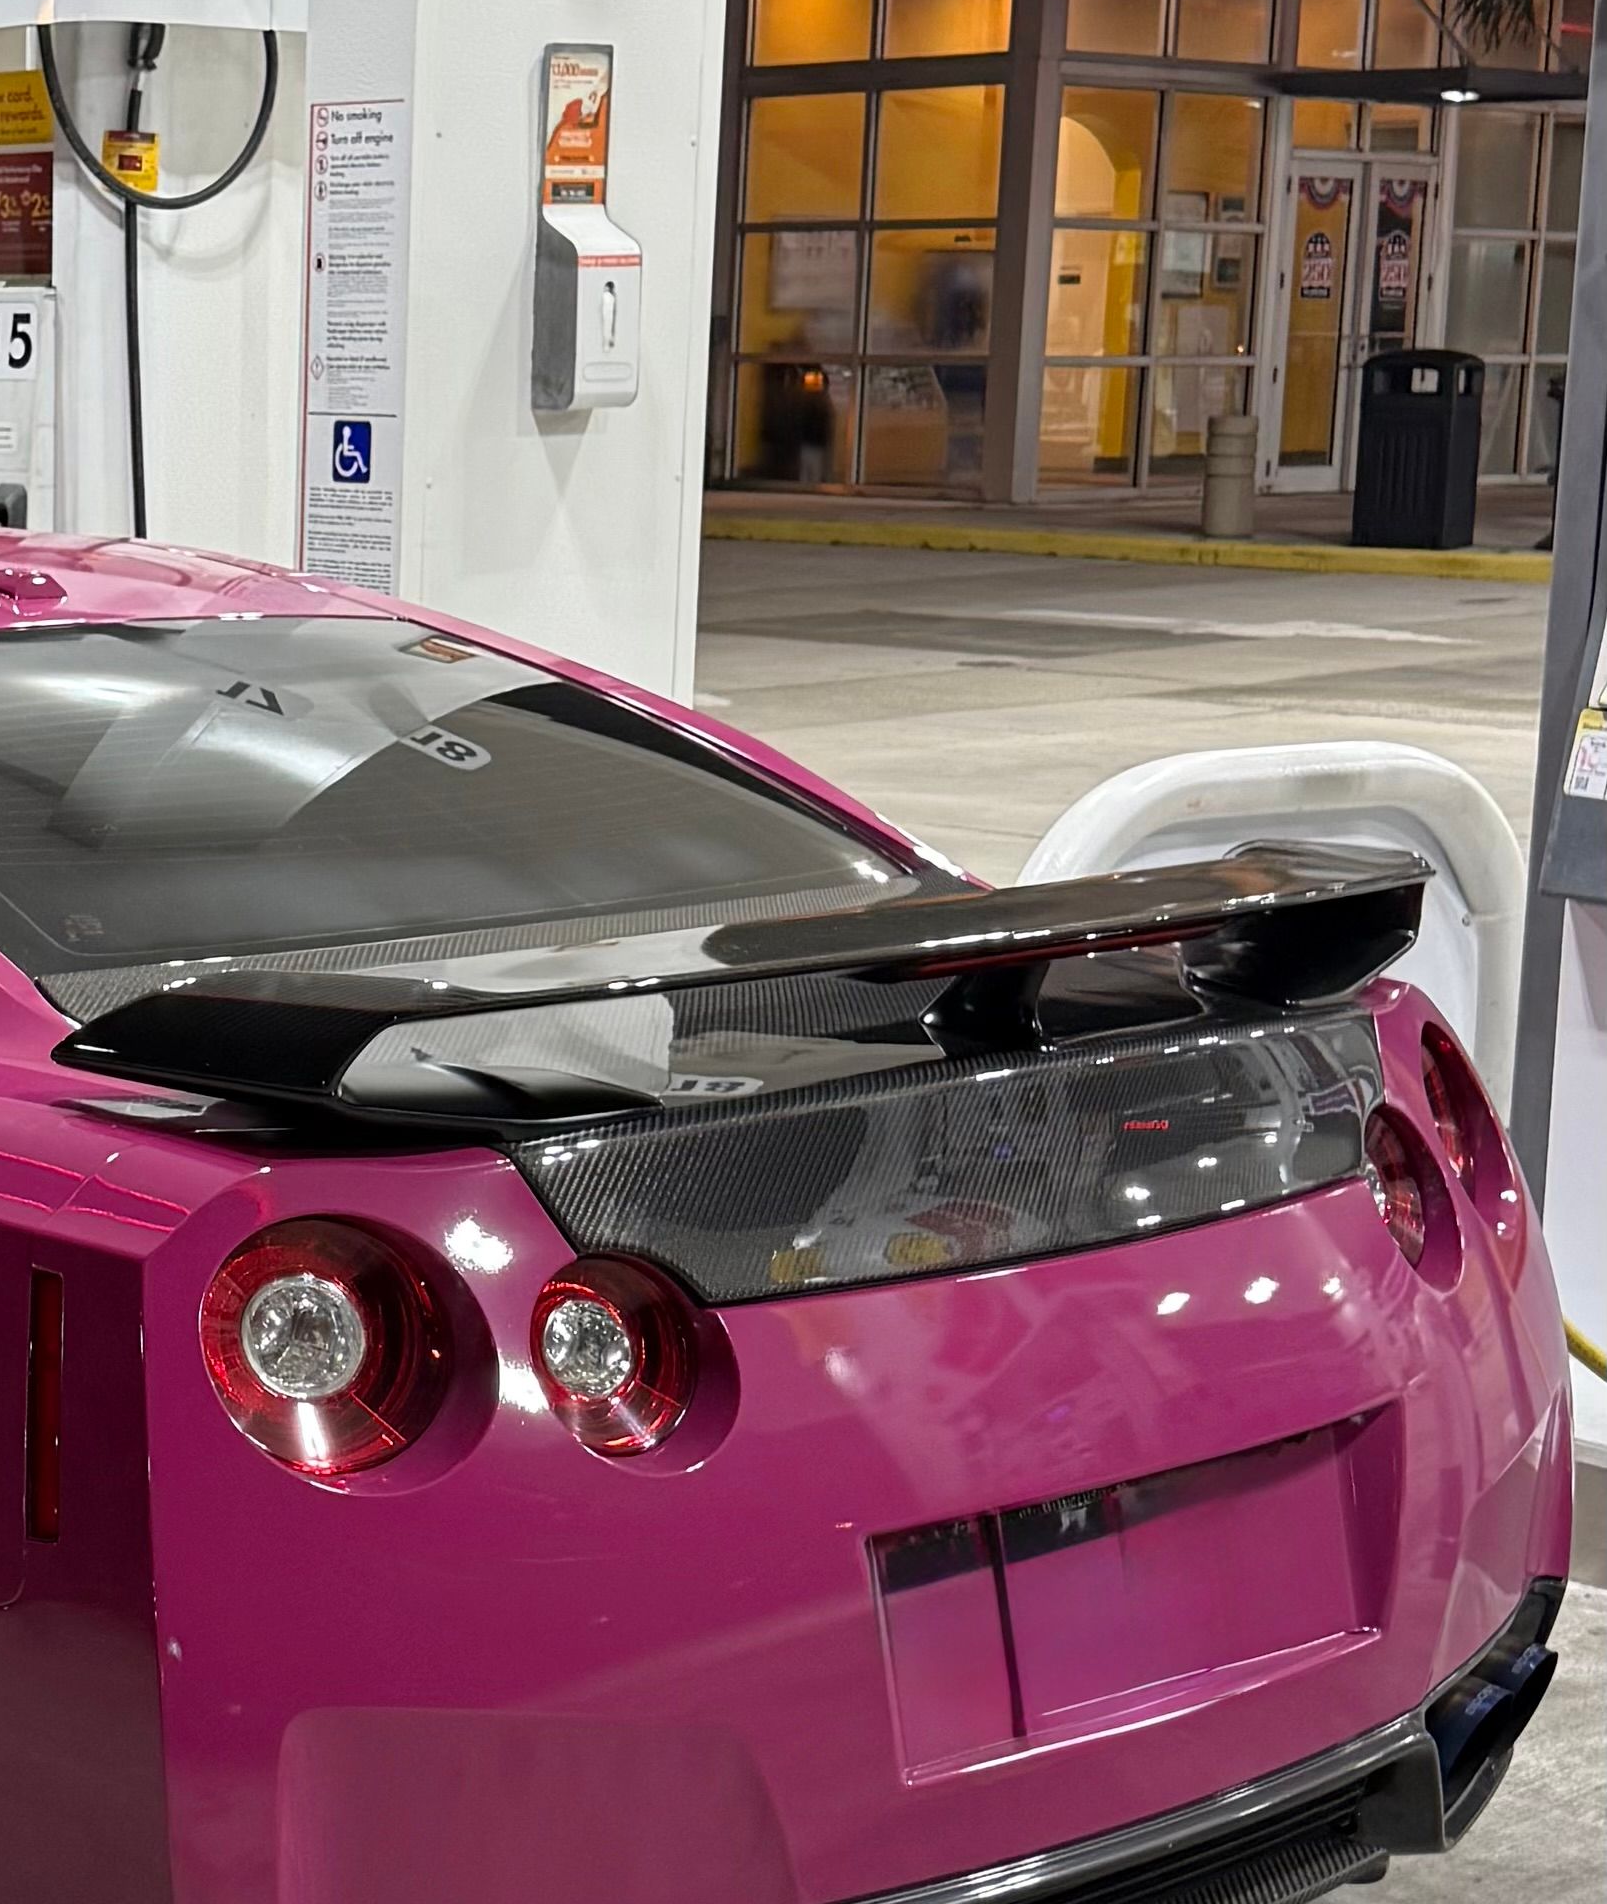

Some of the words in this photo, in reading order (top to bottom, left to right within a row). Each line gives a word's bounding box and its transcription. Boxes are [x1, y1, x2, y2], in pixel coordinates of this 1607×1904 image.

[331, 110, 344, 122] No
[346, 107, 382, 124] smoking
[330, 132, 348, 145] Turn
[350, 130, 363, 145] off
[364, 130, 394, 147] engine
